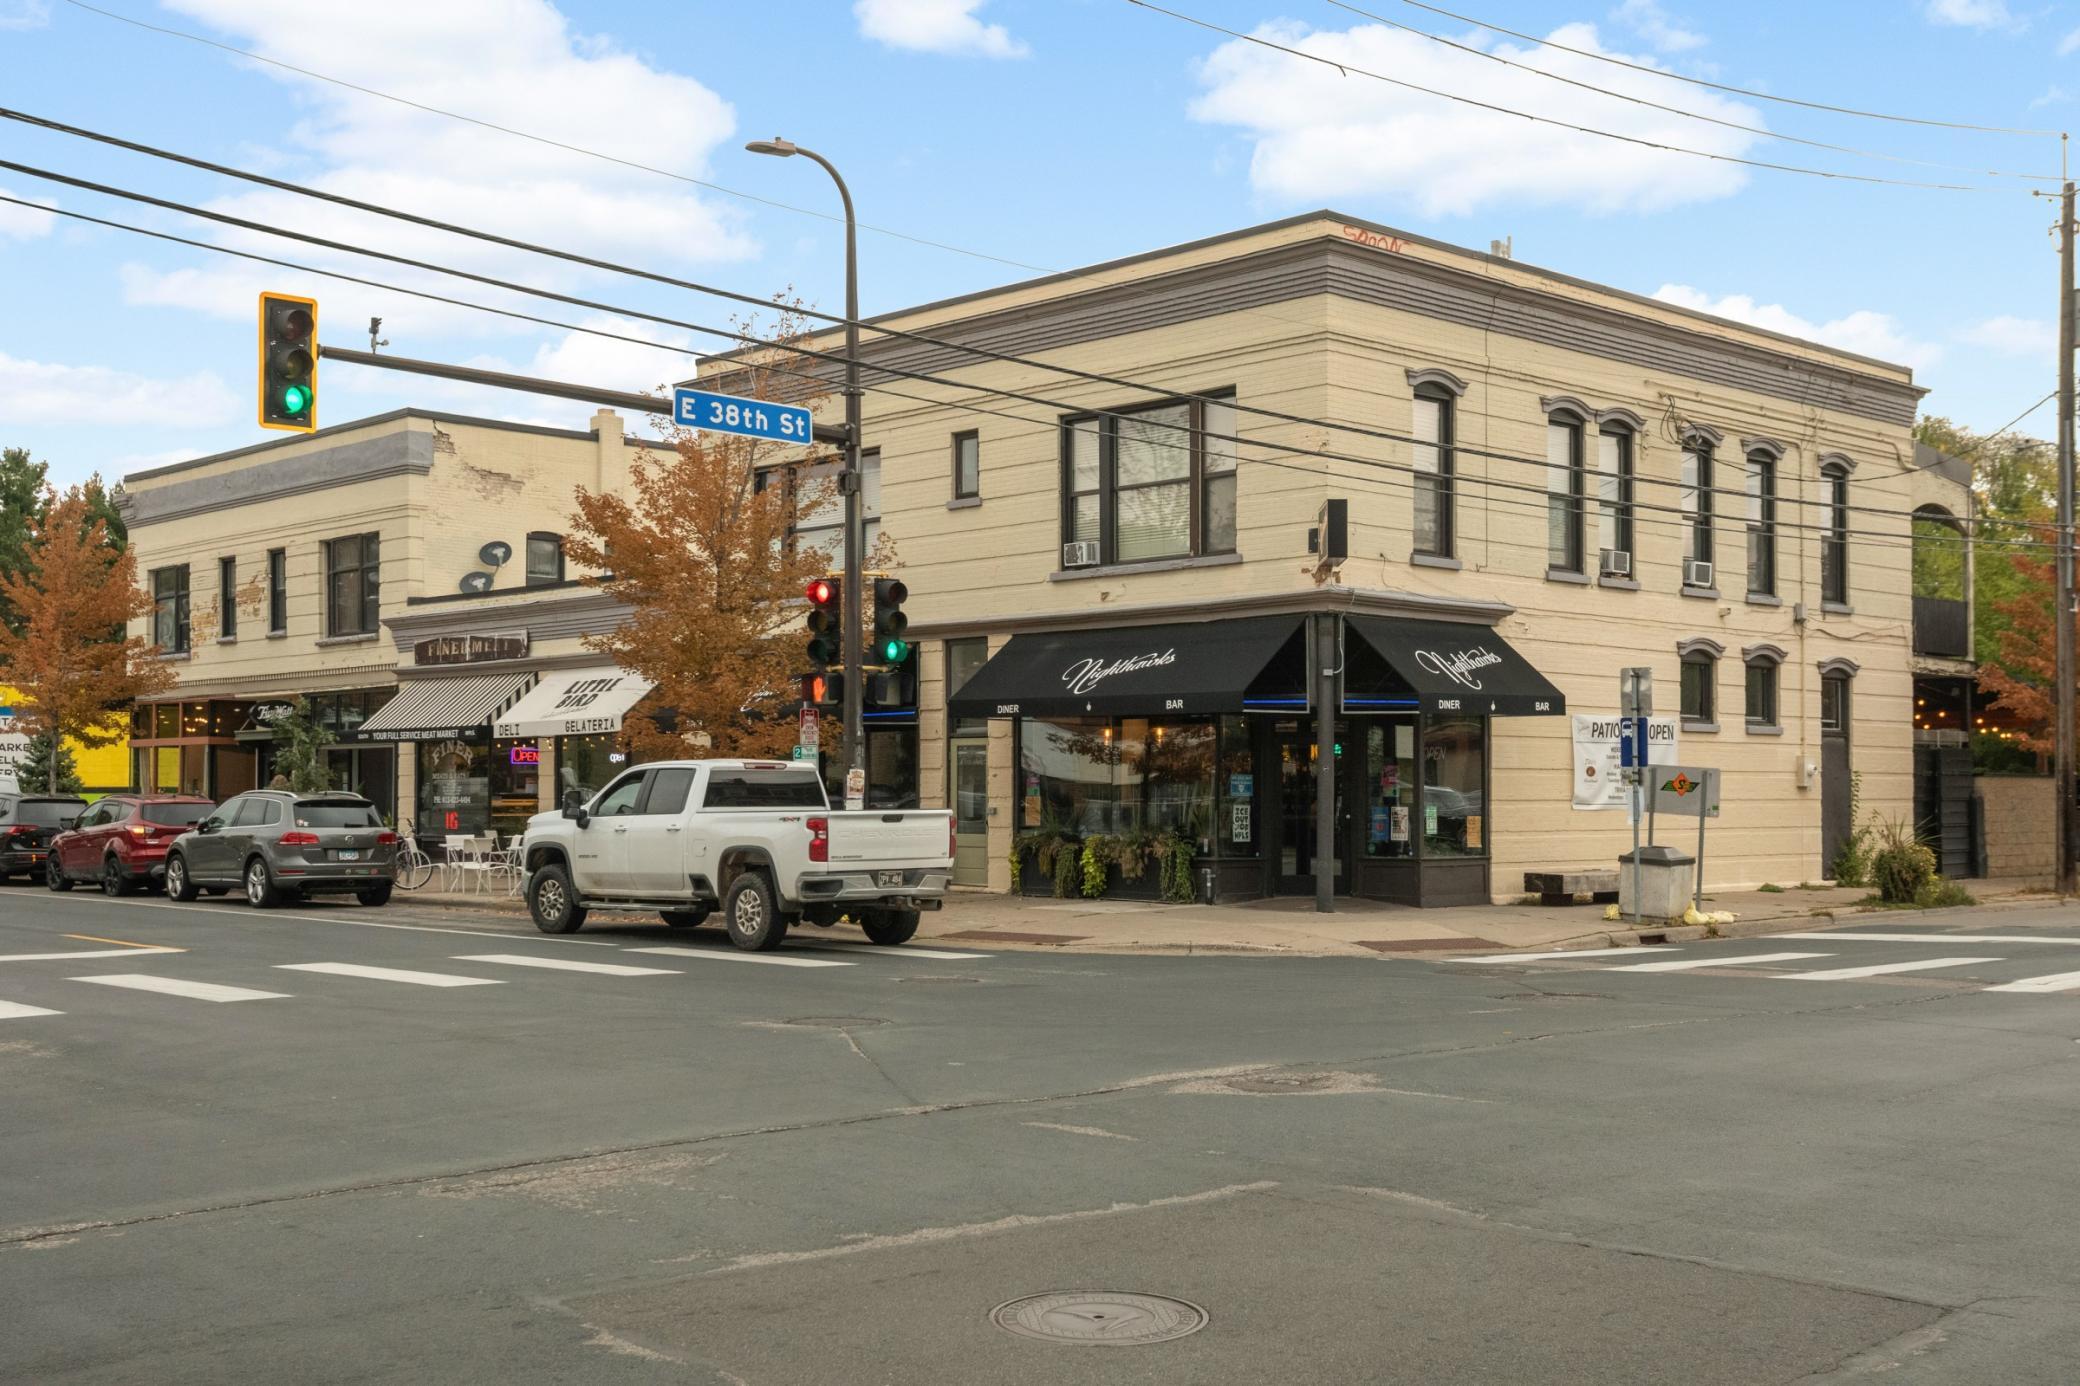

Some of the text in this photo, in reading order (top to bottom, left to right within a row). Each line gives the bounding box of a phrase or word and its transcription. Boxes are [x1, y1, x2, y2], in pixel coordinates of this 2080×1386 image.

[681, 396, 805, 437] E 38th St
[563, 678, 624, 695] LITTLE
[554, 693, 599, 709] BIRD
[997, 699, 1184, 714] DINER BAR
[1438, 699, 1550, 712] DINER BAR
[373, 731, 388, 740] YOUR
[388, 731, 400, 740] FULL
[400, 730, 421, 740] SERVICE
[422, 730, 436, 739] MEAT
[437, 729, 459, 738] MARKET
[499, 719, 615, 737] DELI GELATERIA
[1591, 722, 1620, 739] PATIO
[1649, 724, 1674, 741] OPEN
[1235, 807, 1249, 816] ICE
